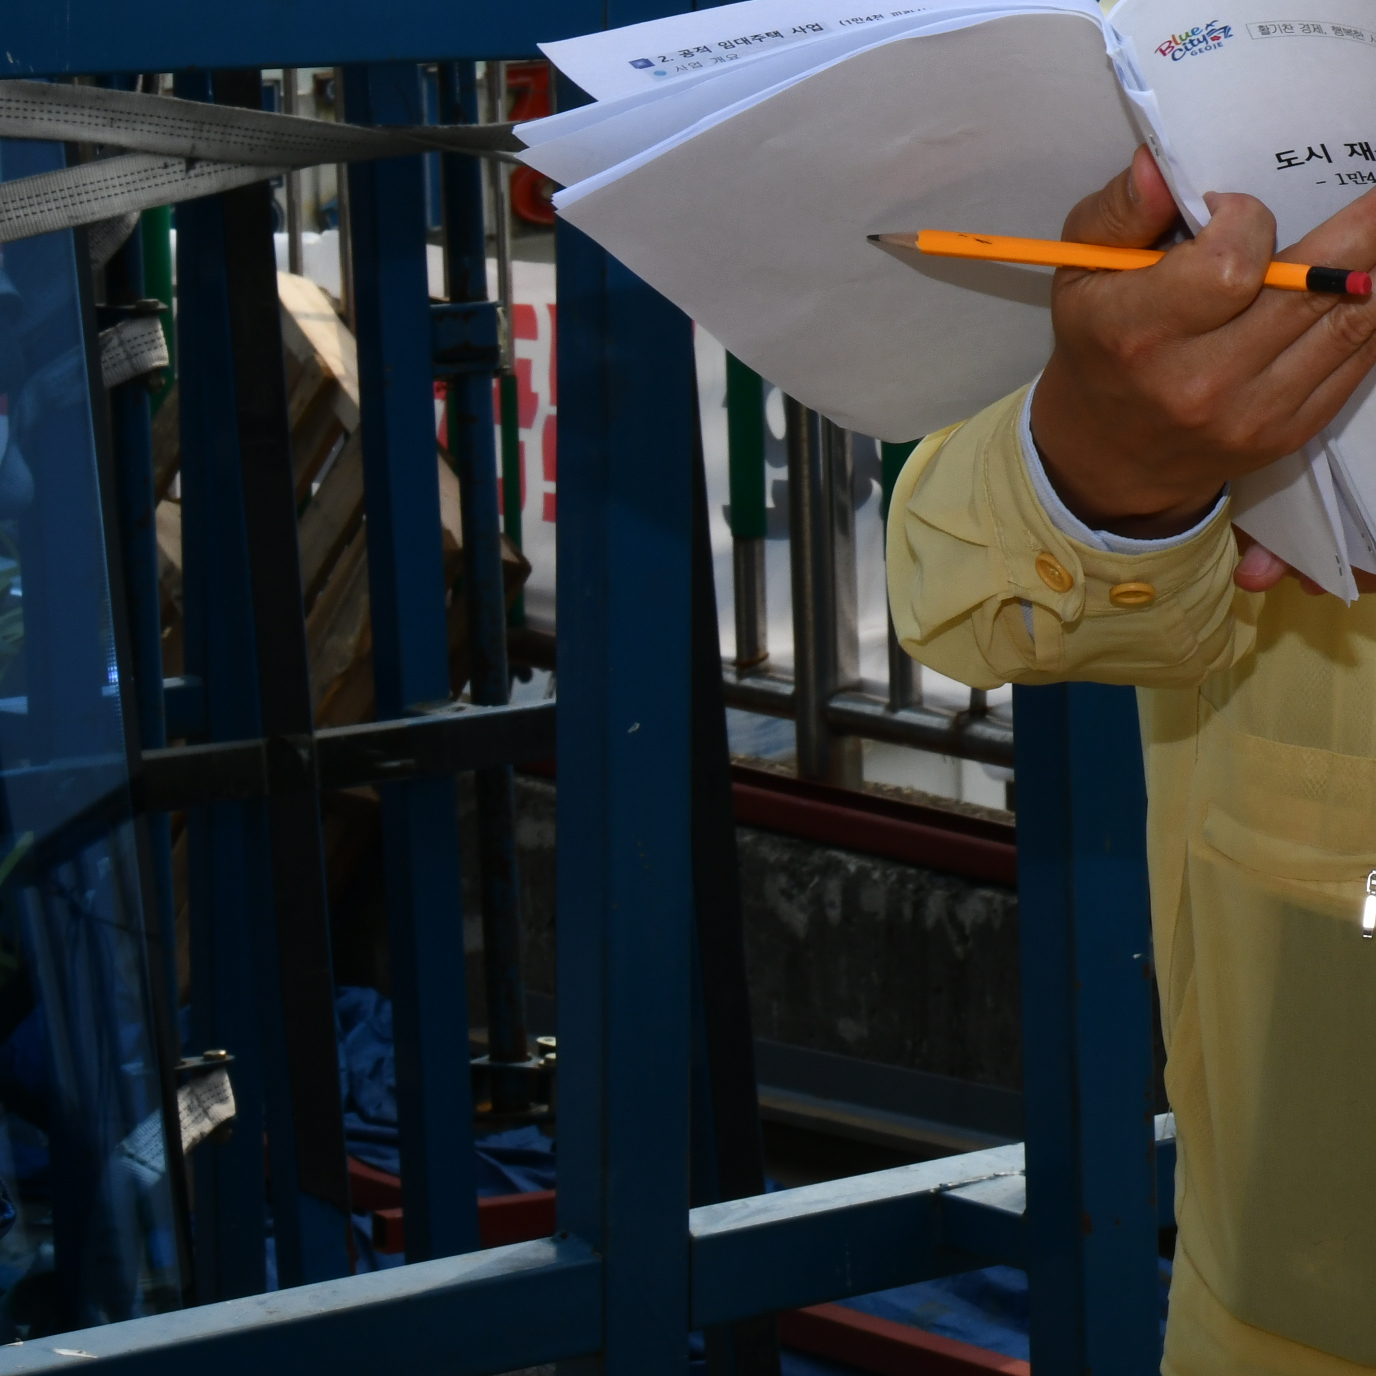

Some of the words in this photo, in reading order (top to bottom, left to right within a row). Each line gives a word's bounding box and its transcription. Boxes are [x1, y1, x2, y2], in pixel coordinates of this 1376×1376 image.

[657, 54, 674, 63] 2.
[679, 45, 712, 58] 공적
[718, 29, 784, 50] 임대주택
[791, 22, 824, 34] 사업
[1155, 27, 1203, 56] Blue
[1171, 34, 1209, 61] City
[1190, 42, 1223, 56] GEOJE
[1275, 143, 1332, 170] 도시
